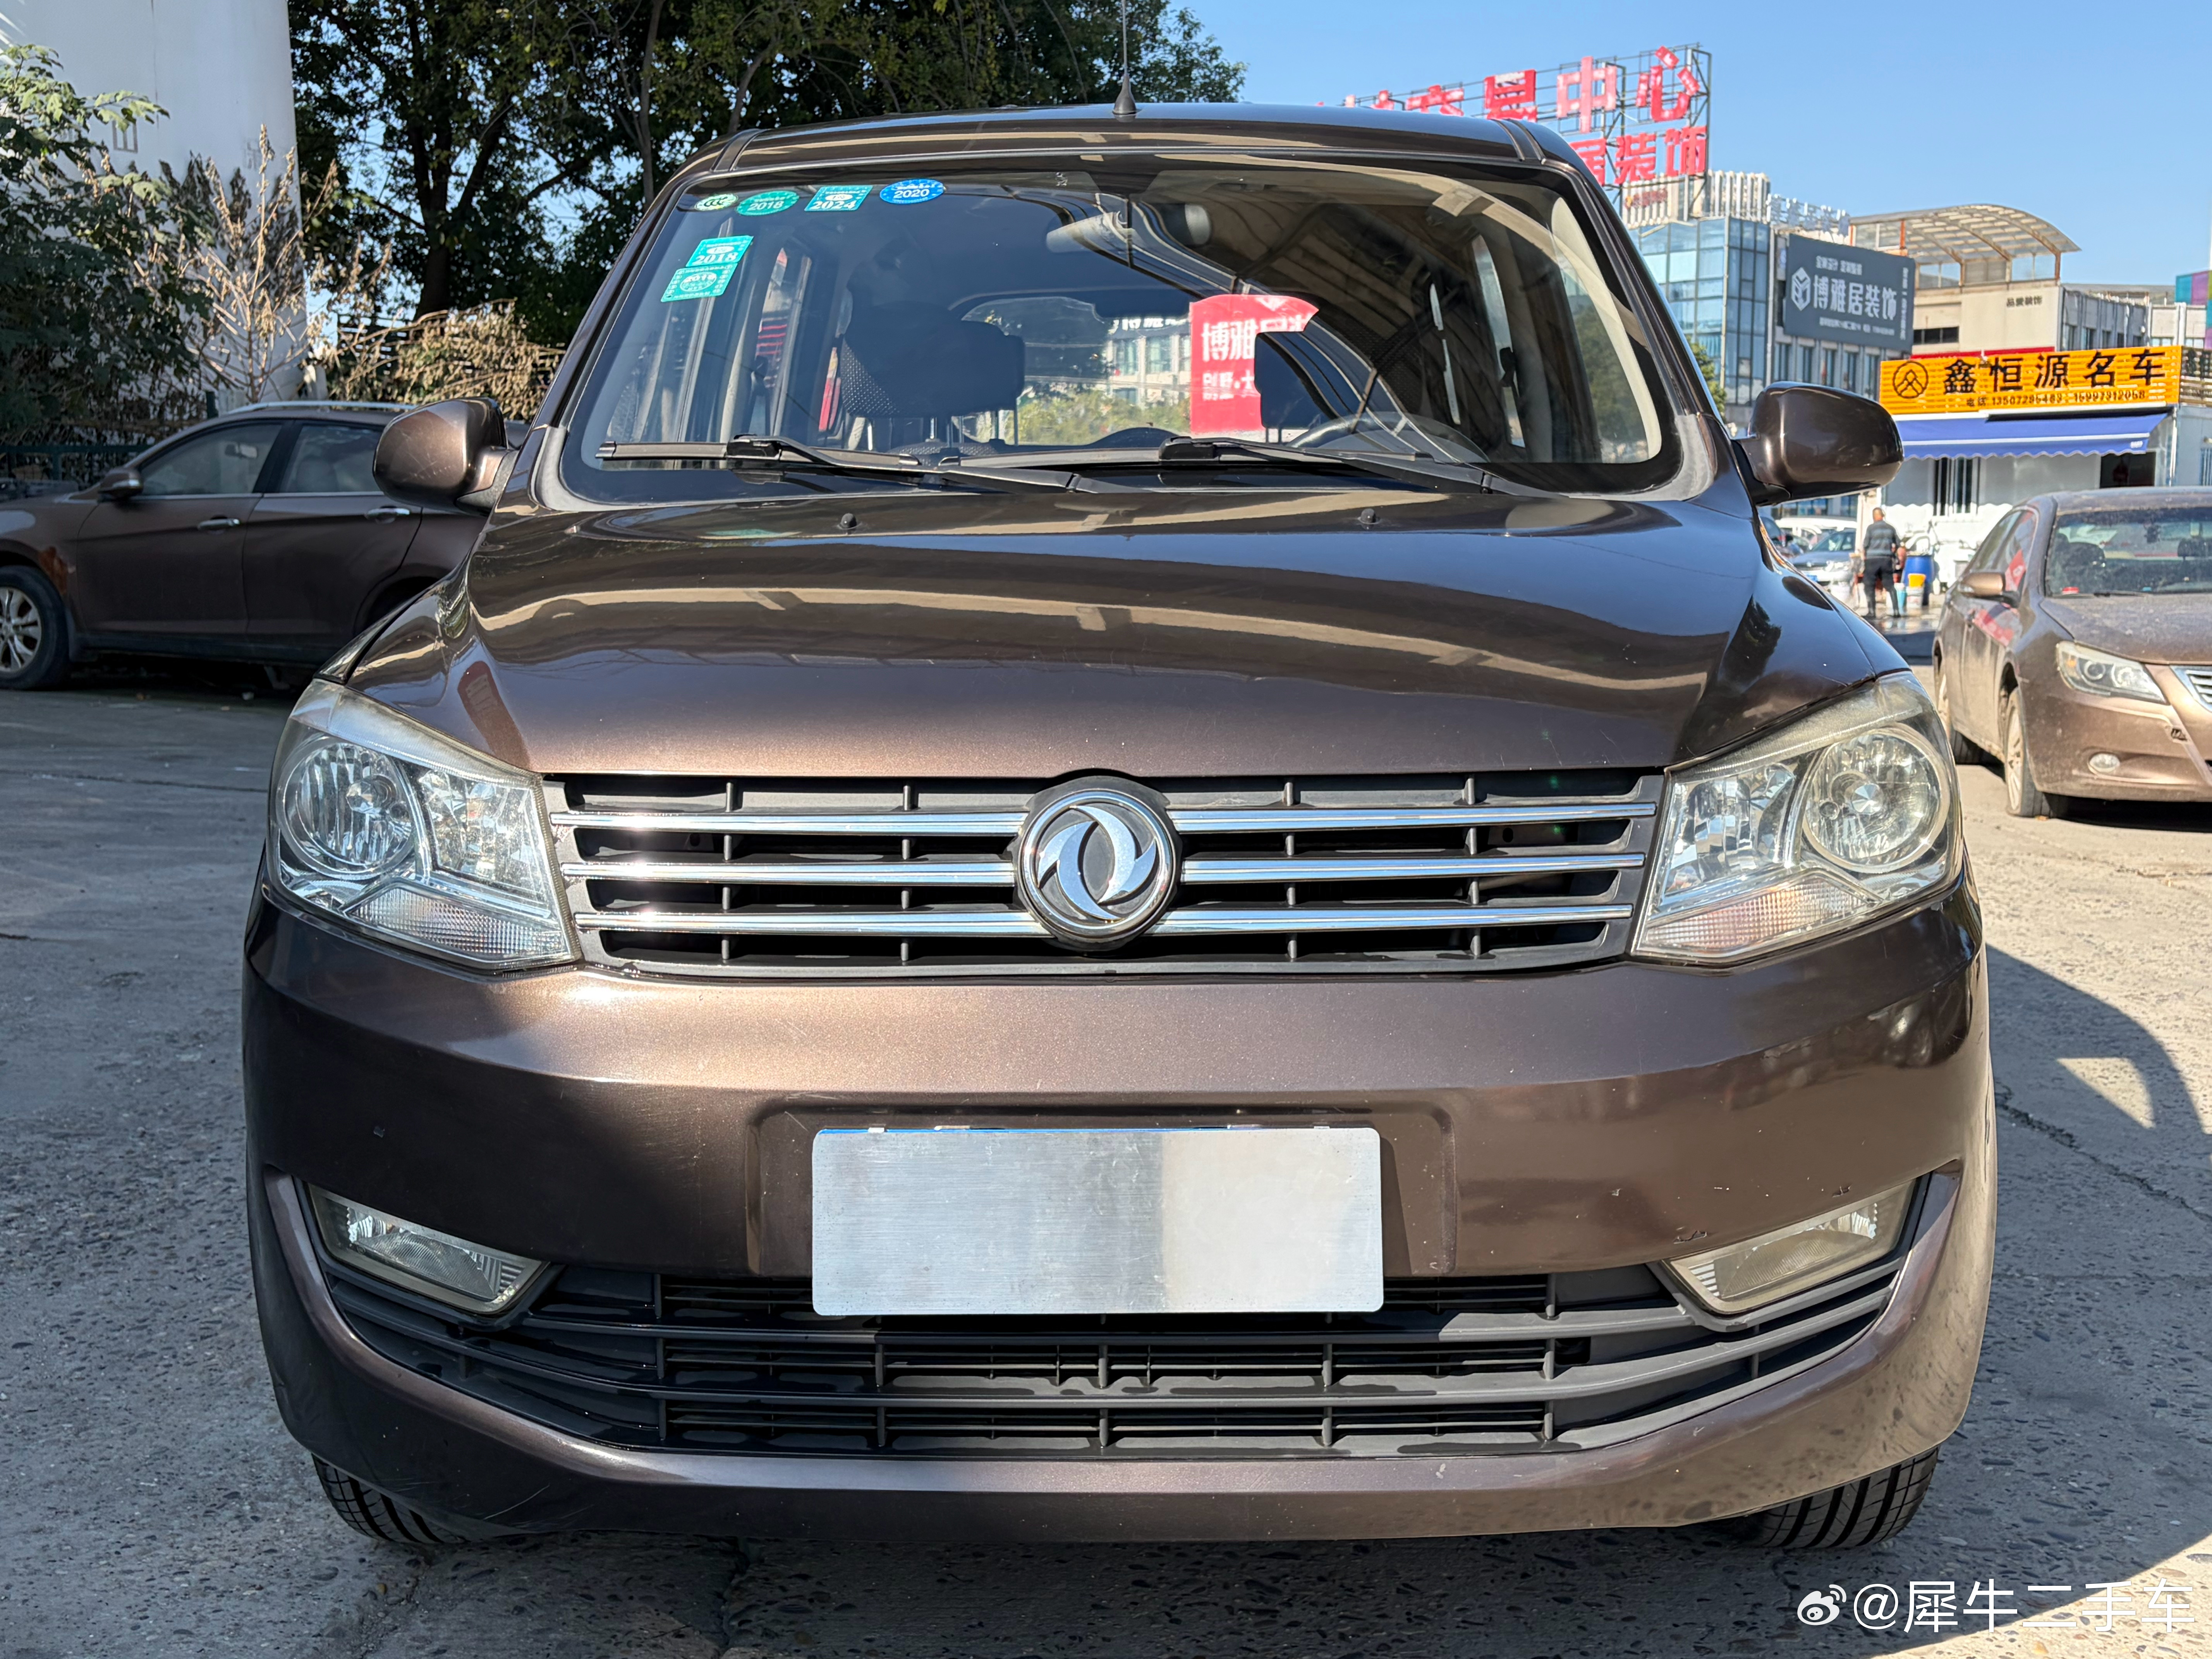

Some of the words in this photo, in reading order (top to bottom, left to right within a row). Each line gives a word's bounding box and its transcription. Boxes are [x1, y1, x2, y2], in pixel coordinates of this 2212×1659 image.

[893, 188, 930, 199] 2020
[810, 200, 857, 210] 2024
[692, 252, 739, 265] 2018
[1813, 274, 1897, 320] 博雅居装饰
[1942, 349, 2166, 395] 鑫恒源名车
